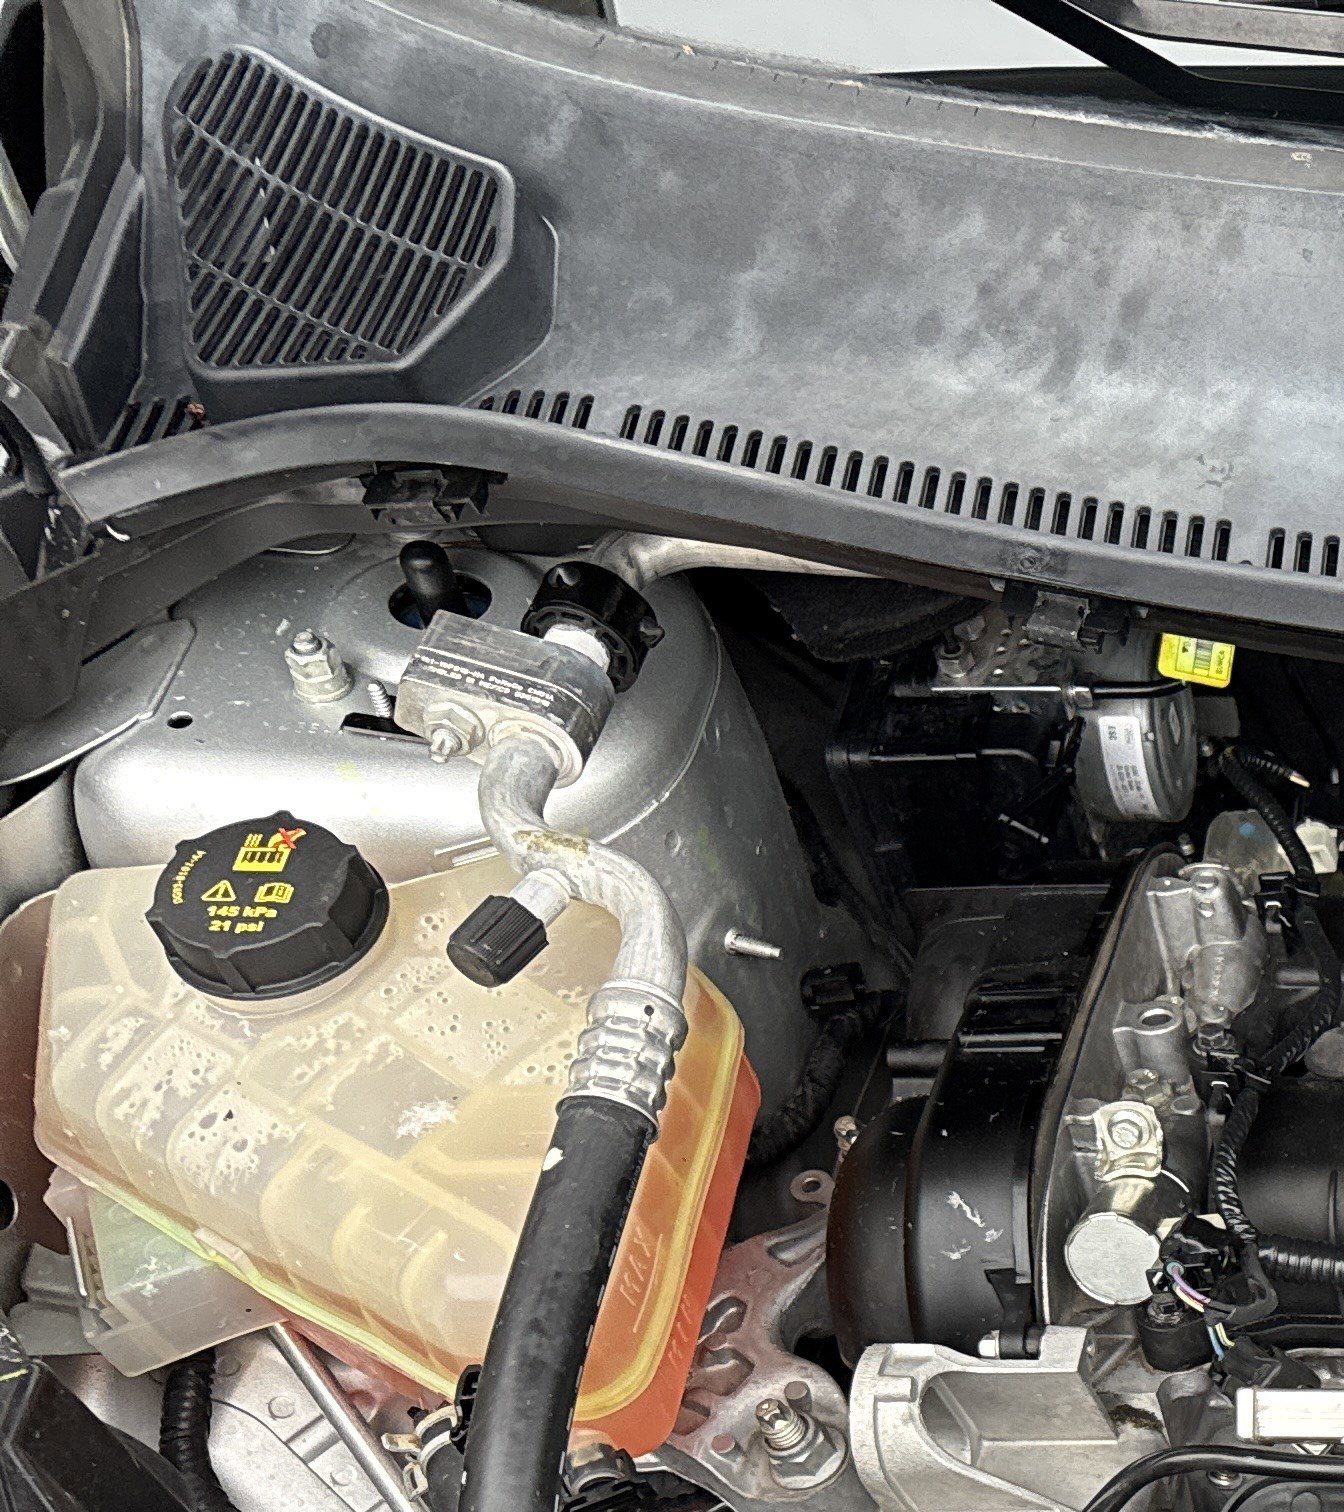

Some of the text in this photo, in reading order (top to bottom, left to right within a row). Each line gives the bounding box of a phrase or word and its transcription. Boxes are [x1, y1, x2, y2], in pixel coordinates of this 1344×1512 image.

[207, 905, 278, 918] 145 kPa
[208, 920, 265, 934] 21 psi
